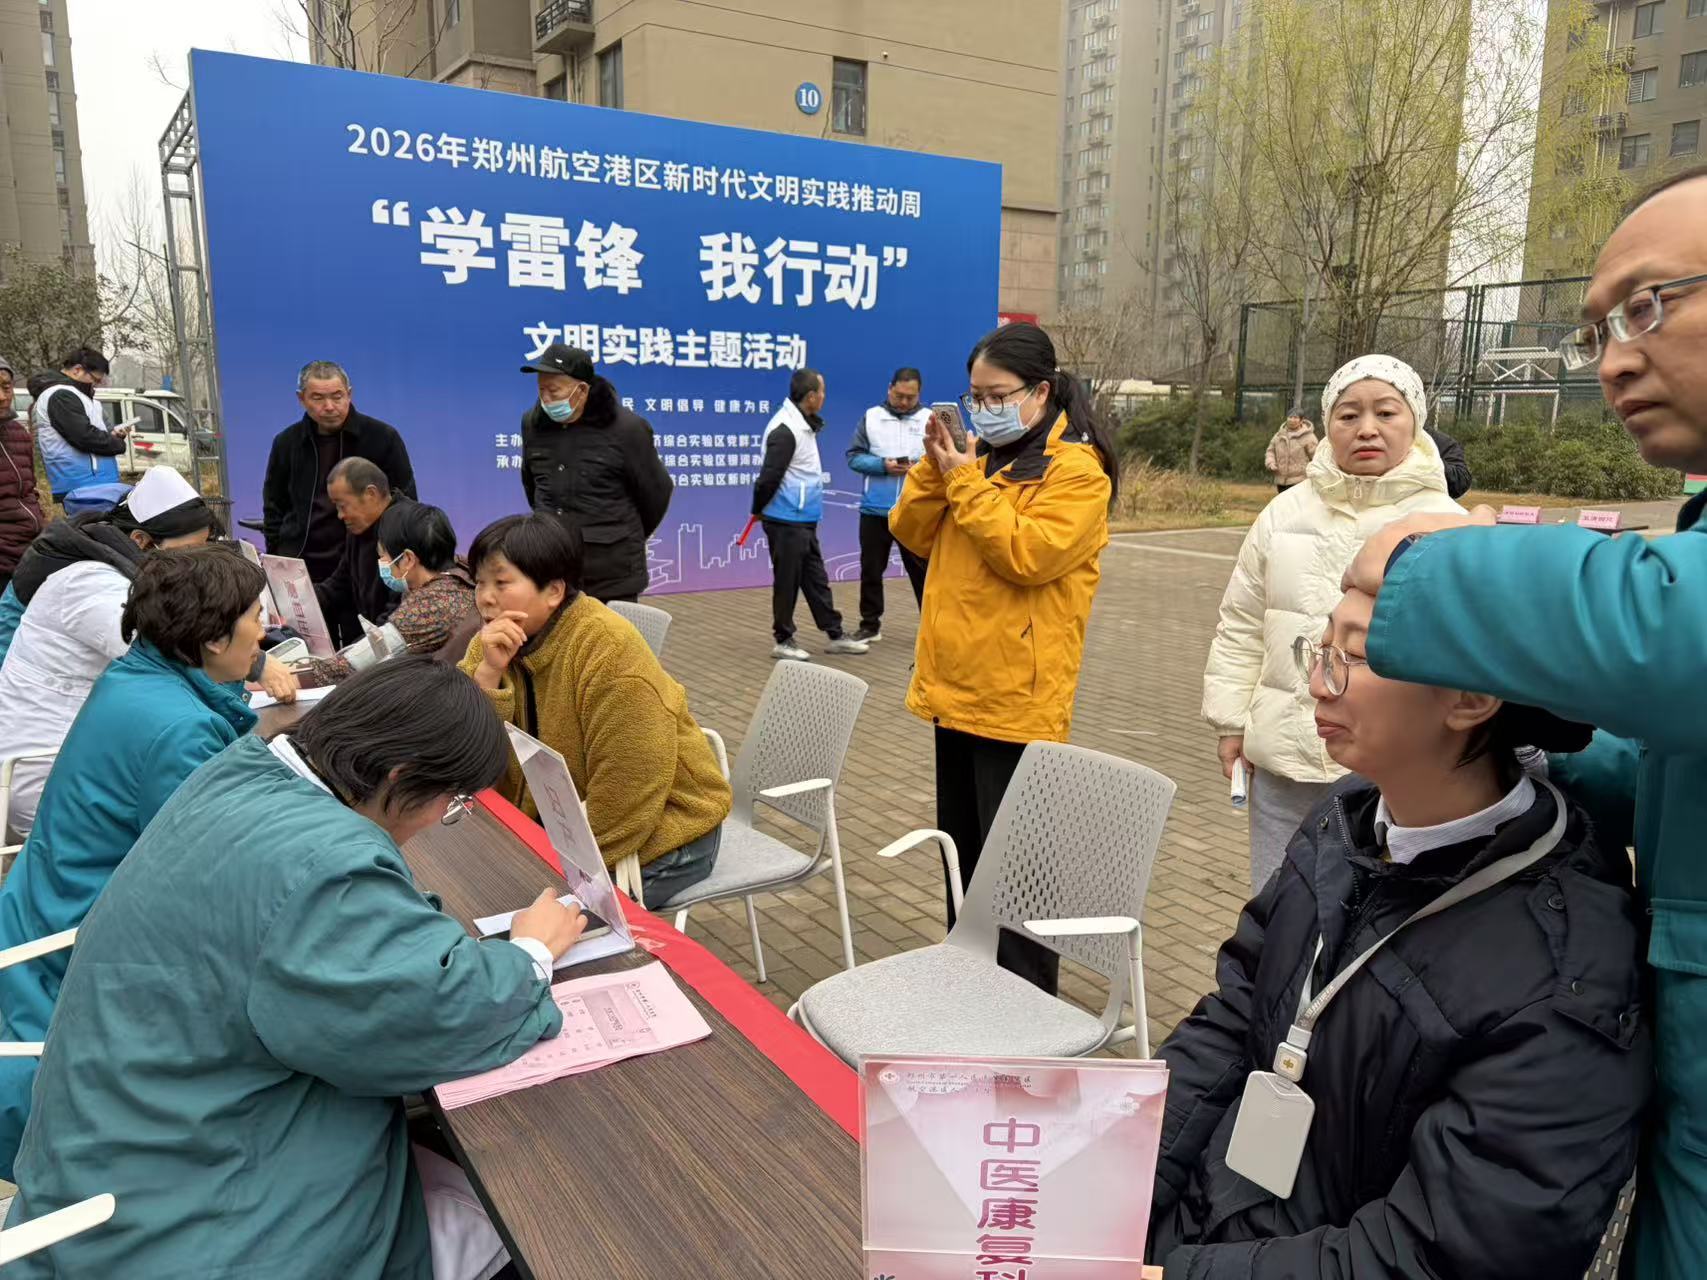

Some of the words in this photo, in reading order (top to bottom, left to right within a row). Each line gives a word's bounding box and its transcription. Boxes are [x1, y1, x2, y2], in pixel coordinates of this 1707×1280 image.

[798, 88, 819, 107] 10
[345, 123, 921, 219] 2026年郑州航空港区新时代文明实践推动周
[371, 198, 645, 295] “学雷锋
[699, 231, 908, 311] 我行动”
[522, 321, 807, 370] 文明实践主题活动
[714, 400, 770, 414] 健康为民
